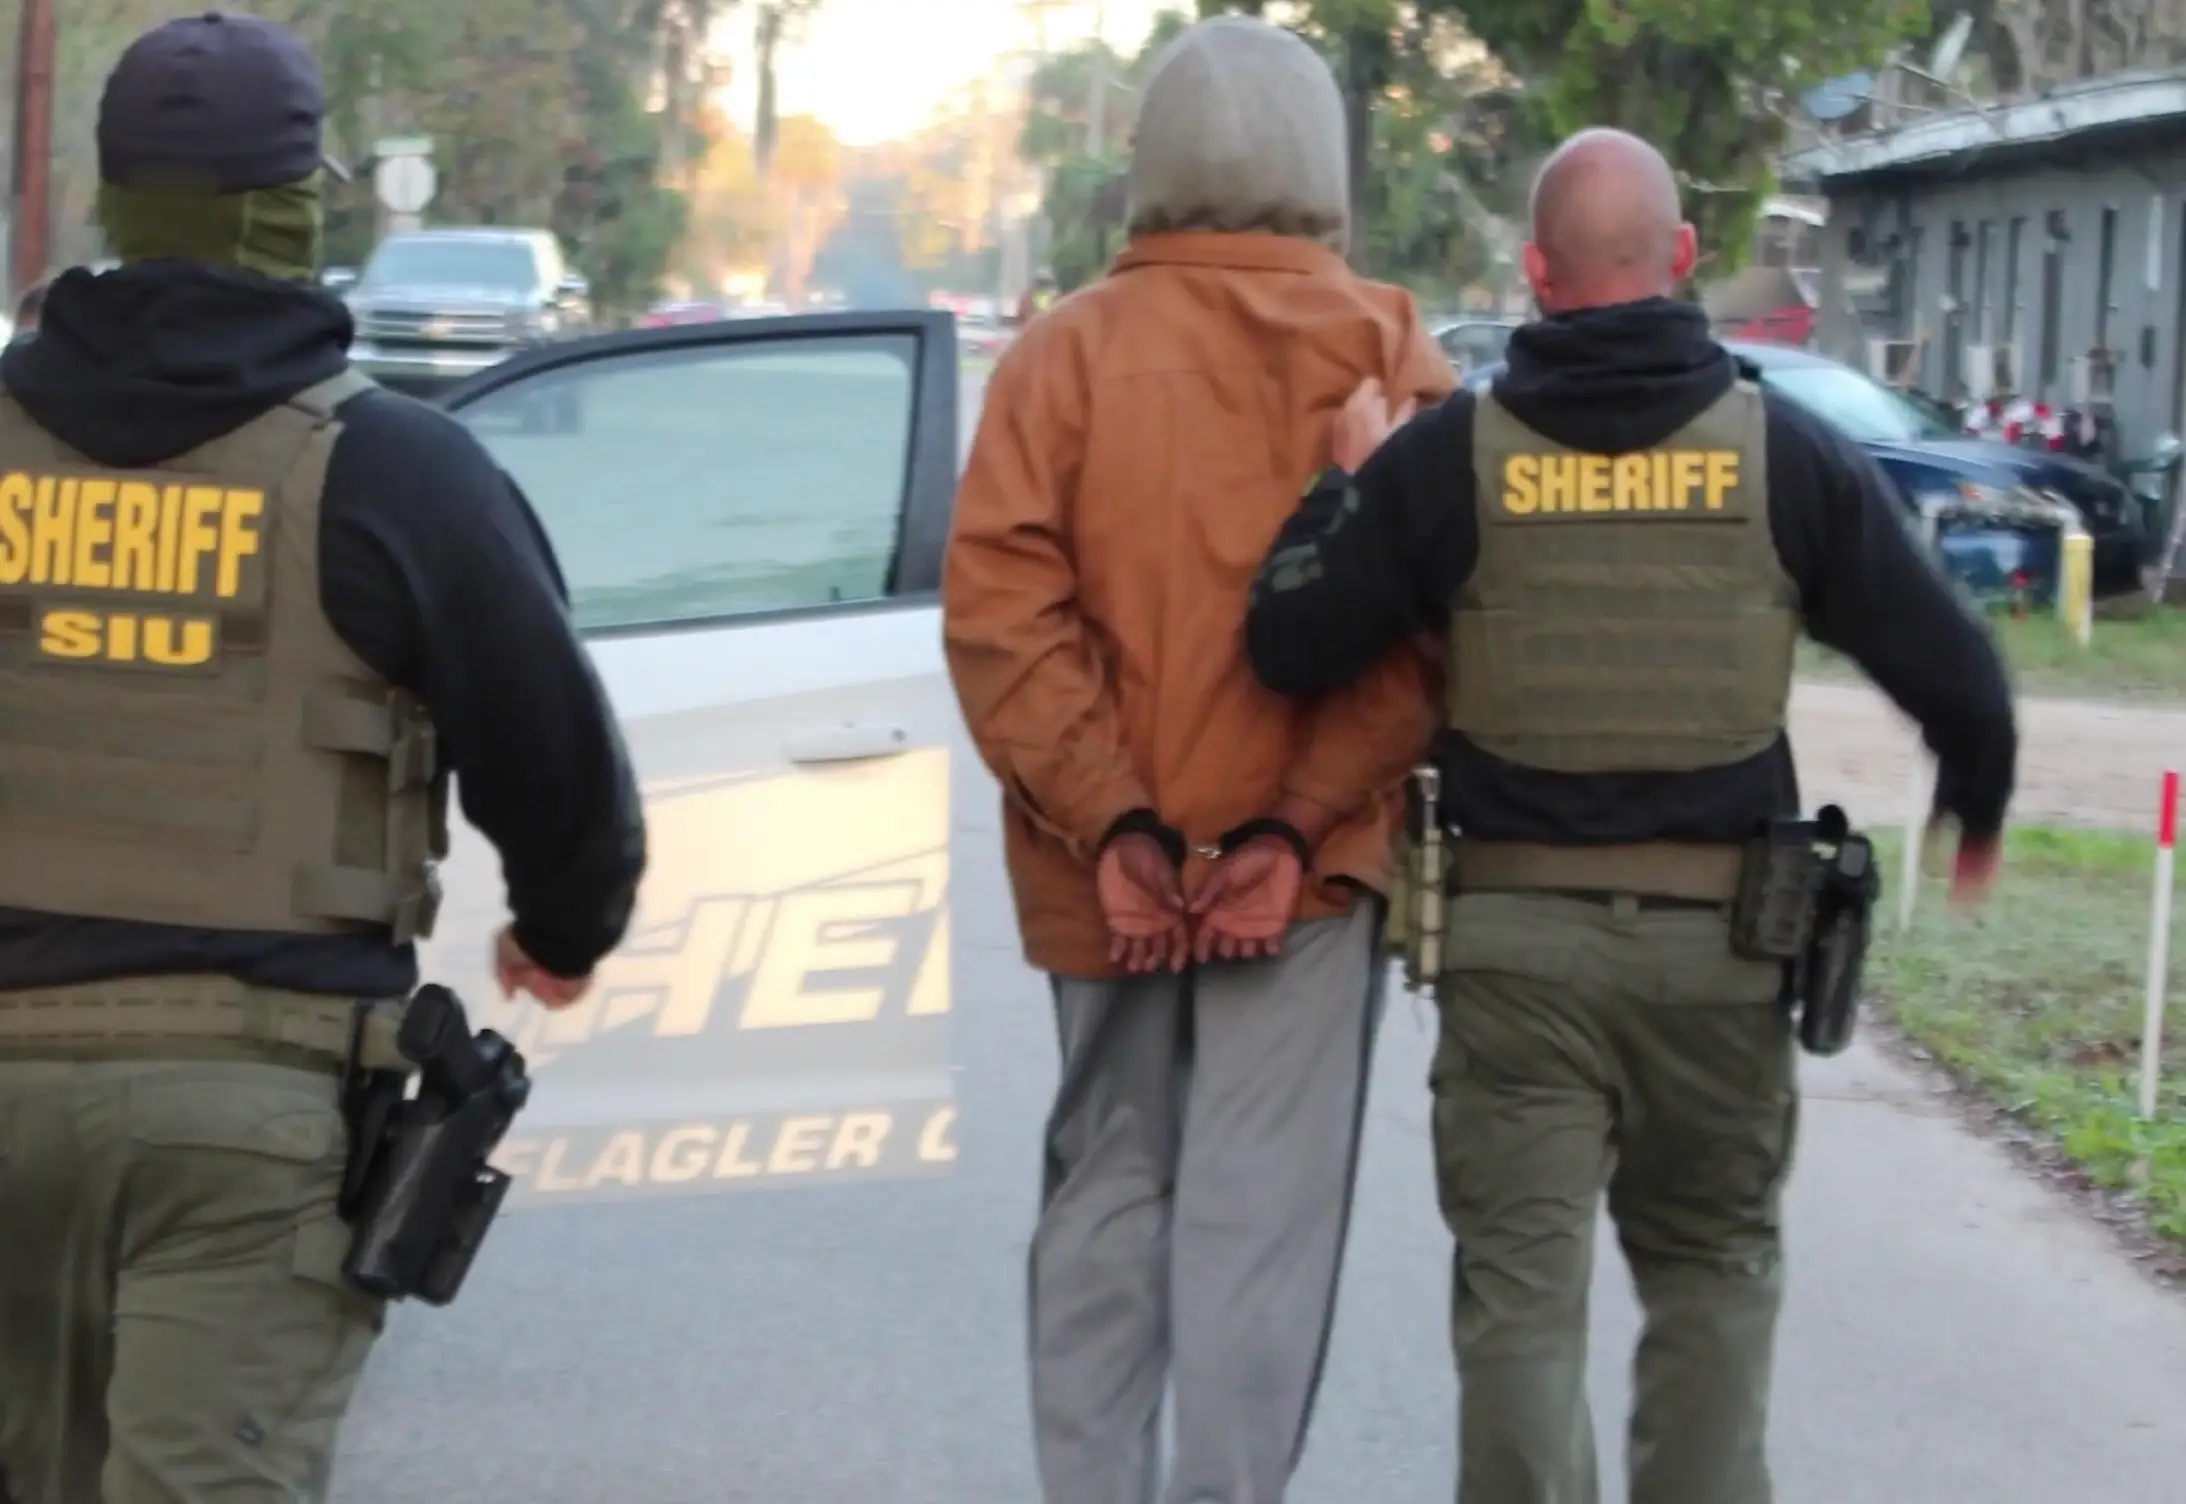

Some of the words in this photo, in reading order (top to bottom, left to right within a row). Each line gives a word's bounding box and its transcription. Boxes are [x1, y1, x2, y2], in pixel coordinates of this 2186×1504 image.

[1503, 452, 1739, 514] SHERIFF
[0, 472, 265, 598] SHERIFF
[40, 611, 212, 665] SIU
[486, 1108, 893, 1186] FLAGLER
